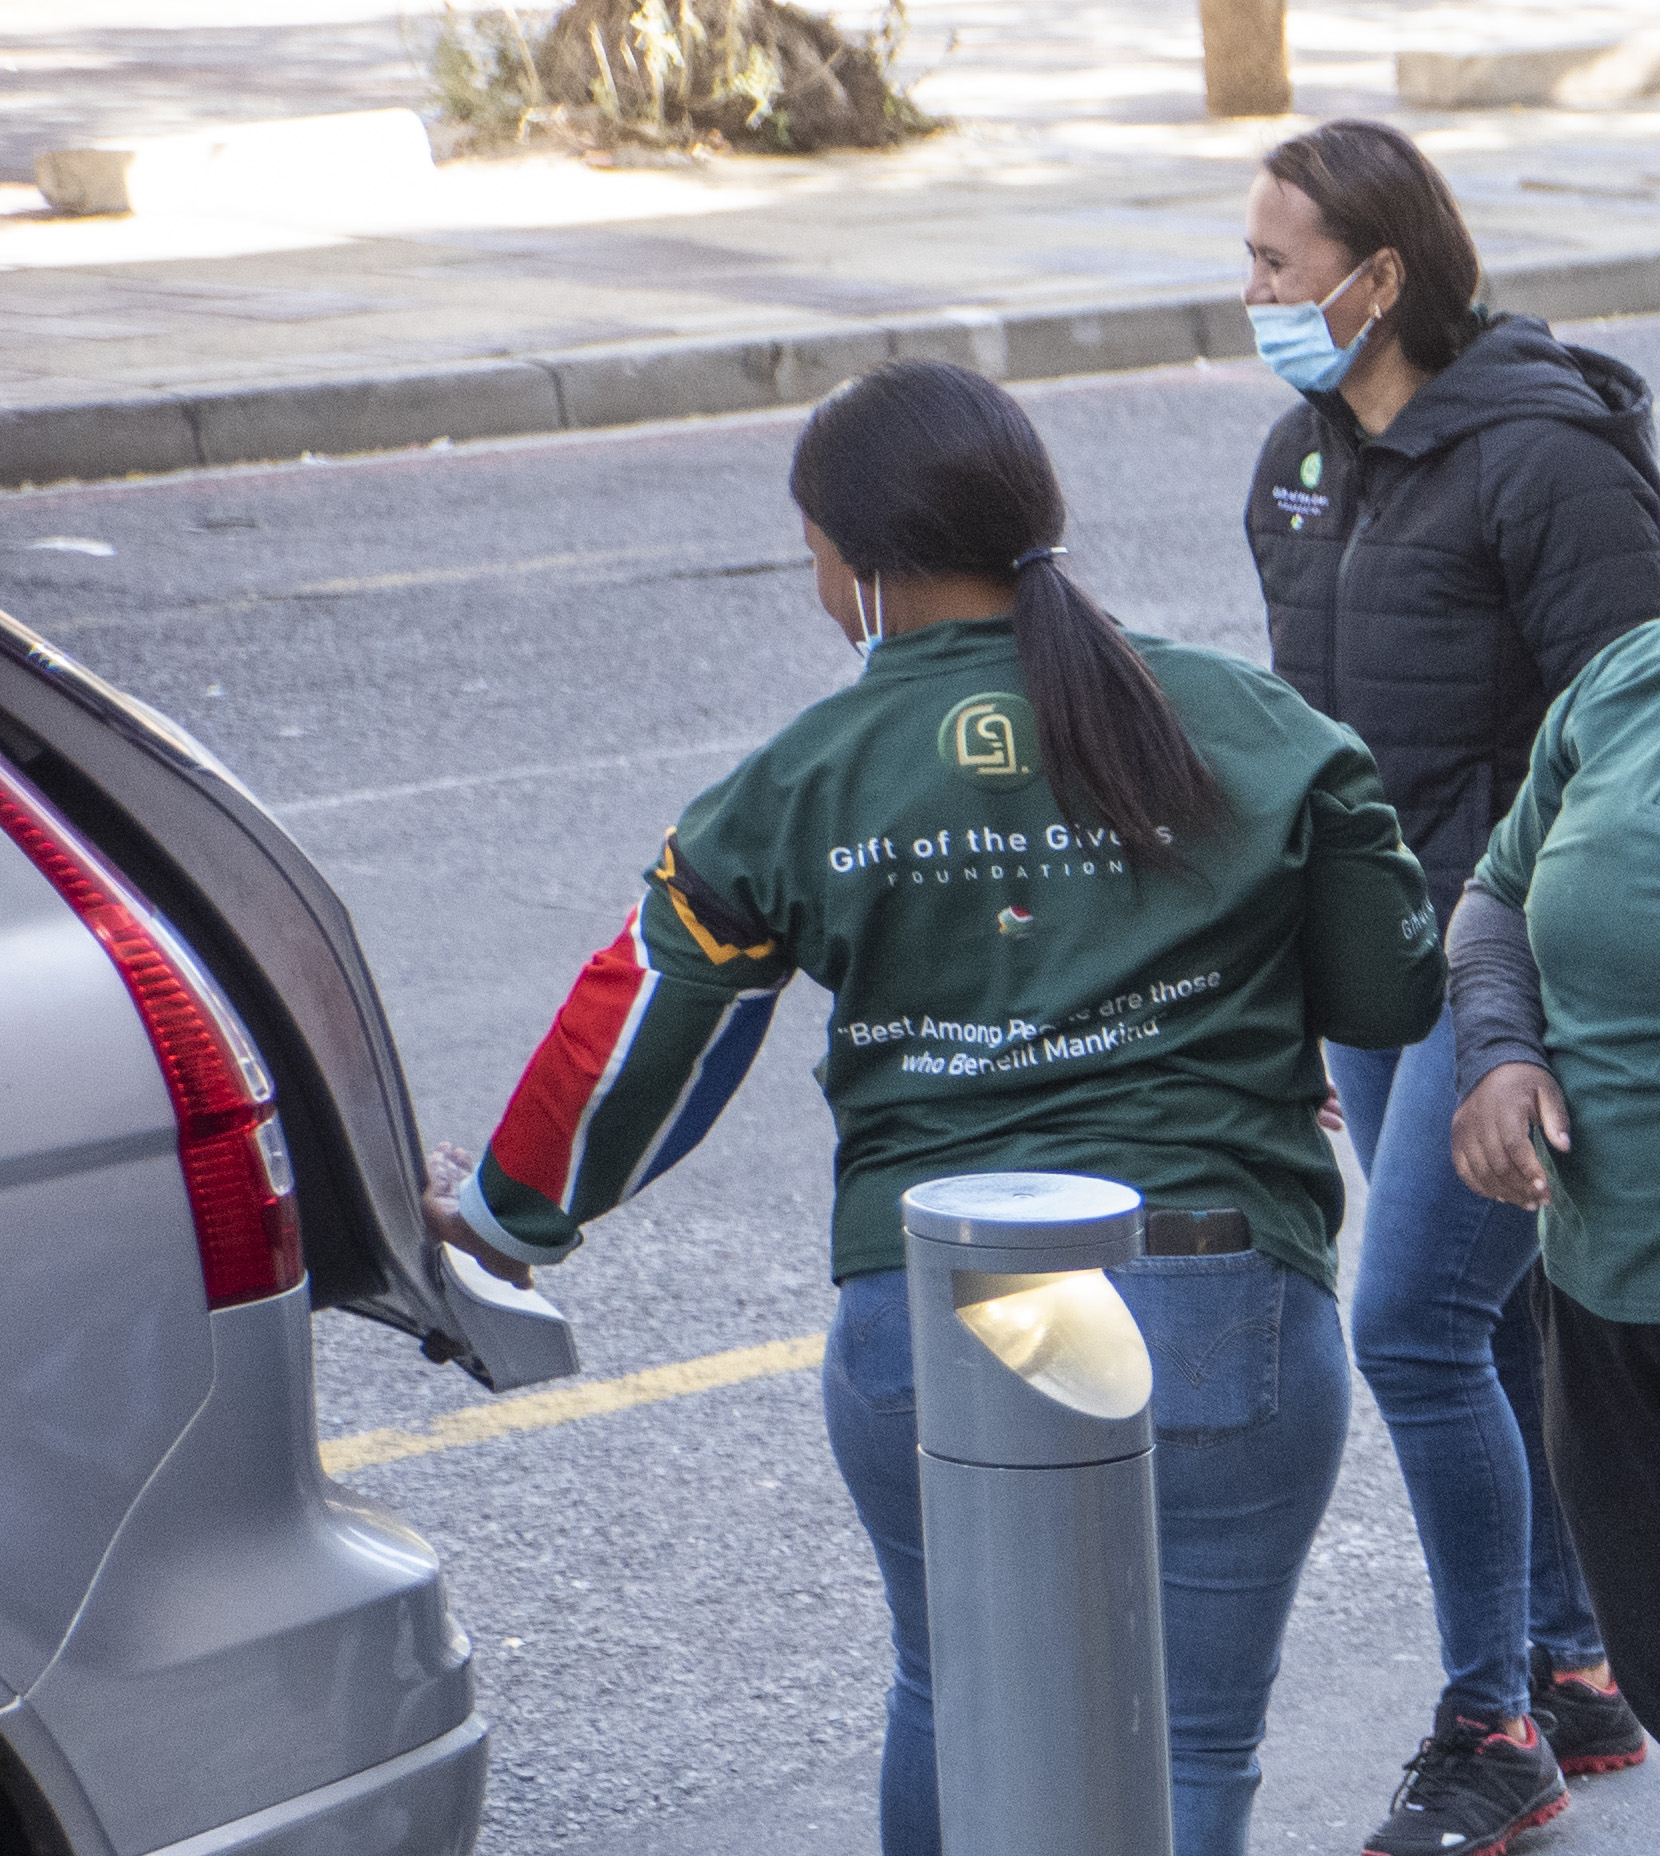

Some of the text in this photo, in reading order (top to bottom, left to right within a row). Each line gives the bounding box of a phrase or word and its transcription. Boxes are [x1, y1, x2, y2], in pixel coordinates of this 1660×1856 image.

[829, 837, 897, 873] Gift
[912, 829, 950, 858] of
[966, 826, 1028, 854] the
[887, 859, 1124, 888] FOUNDATION
[920, 1015, 1002, 1049] Among
[1099, 990, 1143, 1018] are
[1149, 968, 1222, 1004] those
[902, 1050, 945, 1075] who
